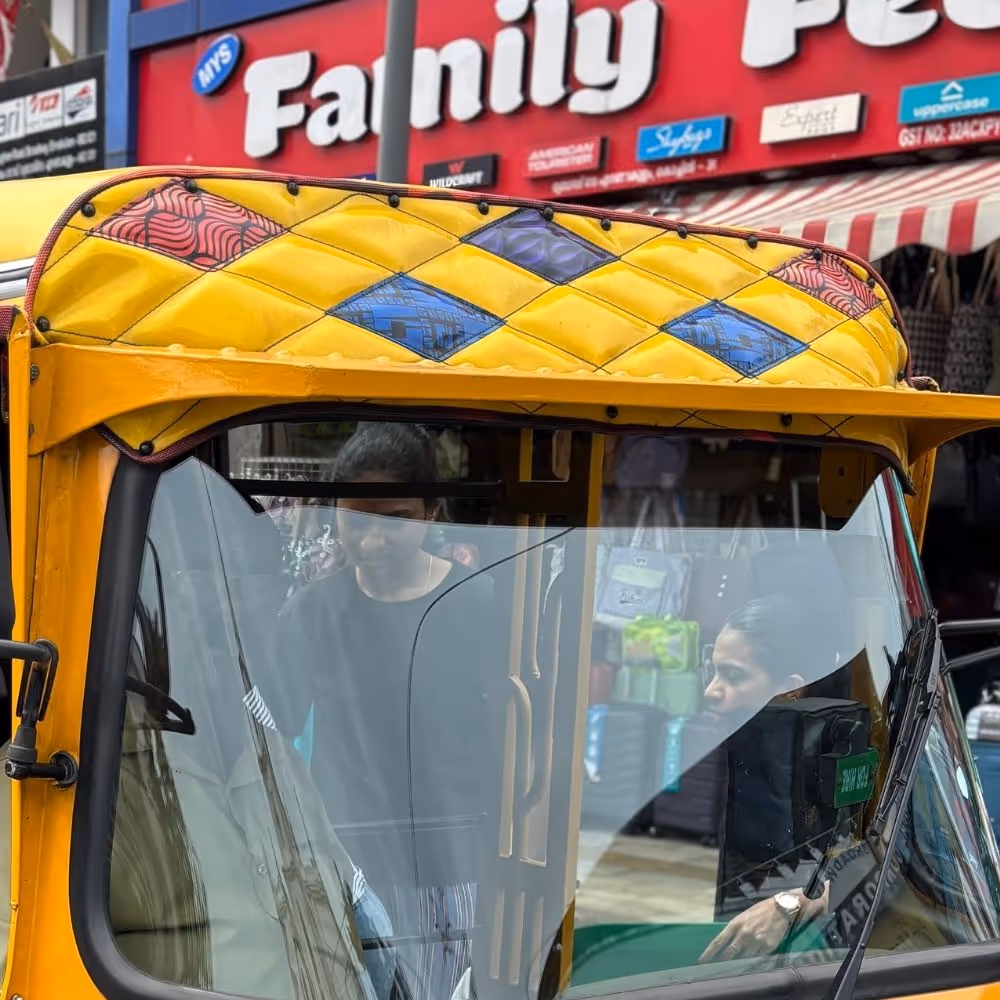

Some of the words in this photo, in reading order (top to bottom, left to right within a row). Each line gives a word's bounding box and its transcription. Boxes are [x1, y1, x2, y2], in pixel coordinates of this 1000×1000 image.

[198, 43, 233, 88] MYS
[243, 0, 662, 158] Family
[913, 97, 990, 120] uppercase
[899, 128, 923, 147] GST
[925, 124, 947, 146] NO:
[528, 142, 594, 161] AMERICAN
[528, 154, 592, 172] TOURISTER
[429, 170, 483, 188] WILDCRAFT
